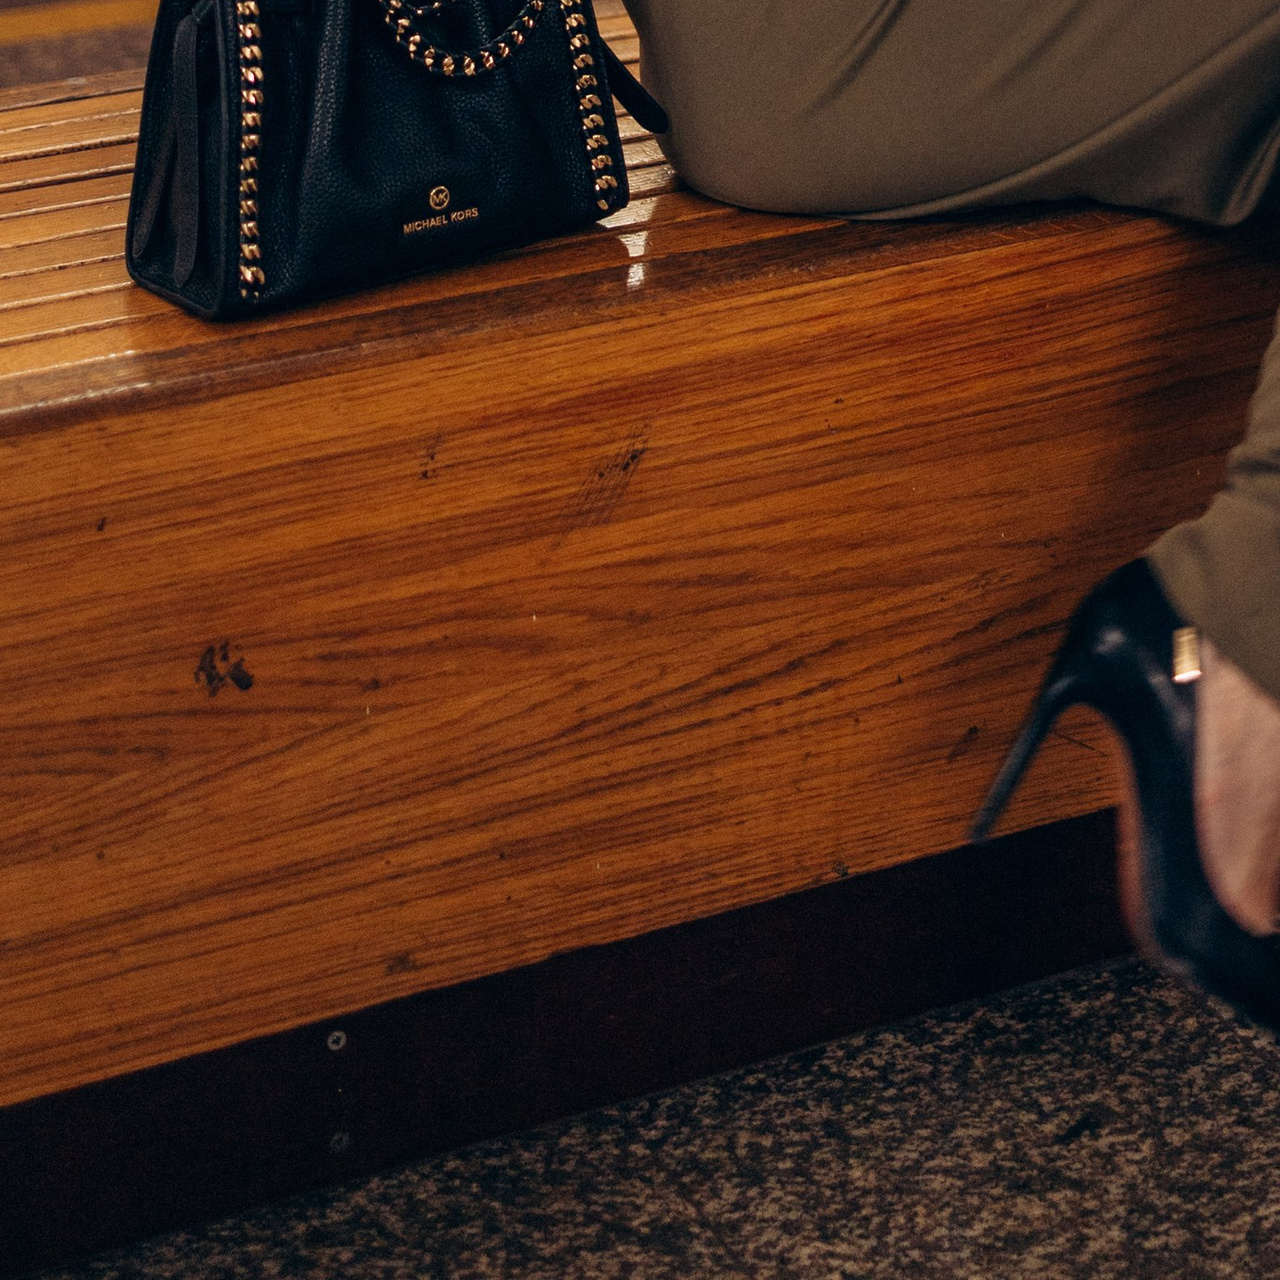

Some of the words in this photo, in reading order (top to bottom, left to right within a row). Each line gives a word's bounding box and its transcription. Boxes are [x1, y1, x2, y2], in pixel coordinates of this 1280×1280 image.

[431, 189, 449, 206] MK
[403, 215, 448, 234] MICHAEL
[450, 207, 479, 222] KORS
